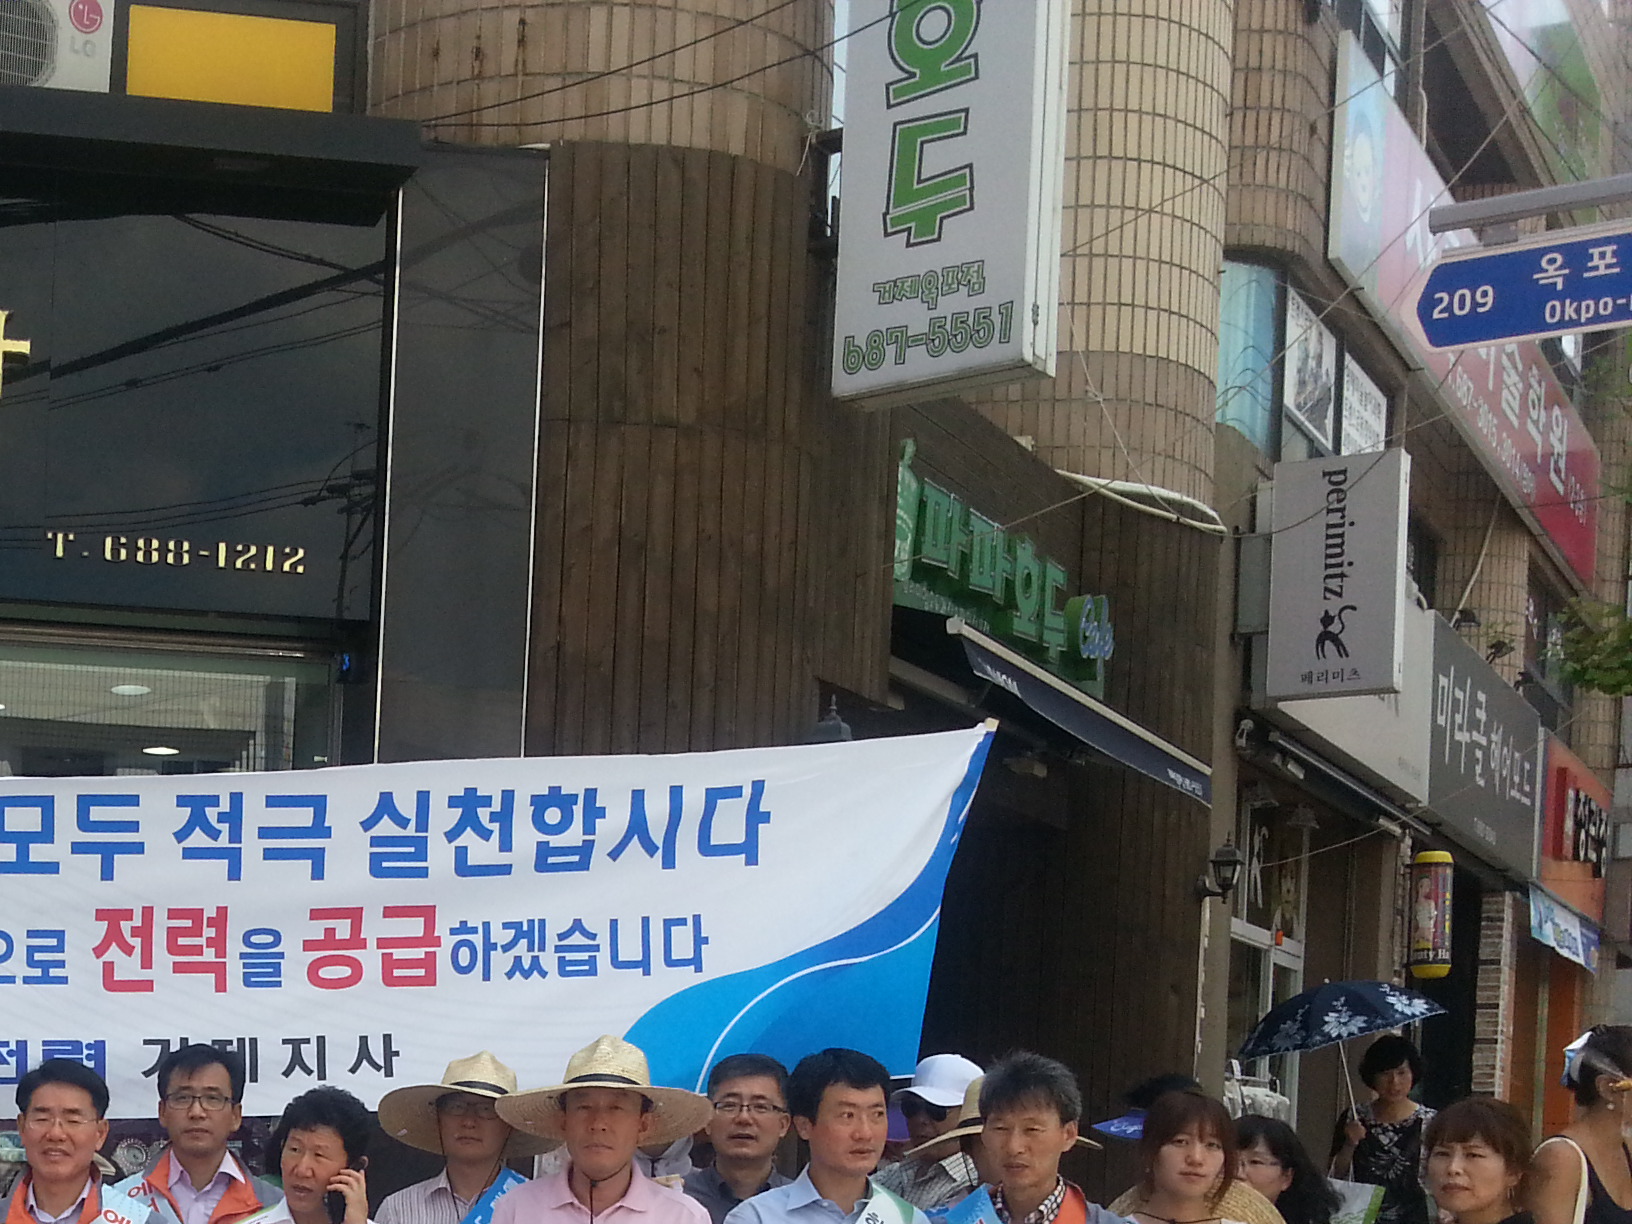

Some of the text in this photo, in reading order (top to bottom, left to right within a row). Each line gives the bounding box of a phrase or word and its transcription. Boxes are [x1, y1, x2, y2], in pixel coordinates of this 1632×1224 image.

[872, 260, 986, 310] 거제옥포점
[1432, 285, 1494, 319] 209
[1544, 293, 1632, 324] Okpo-
[843, 301, 1014, 375] 687-5551
[920, 477, 1068, 664] 파파호두
[1322, 466, 1355, 601] perimitz
[172, 791, 333, 882] 적극
[358, 778, 771, 881] 실천합시다
[91, 904, 286, 994] 전력을
[301, 903, 710, 991] 공급하겠습니다
